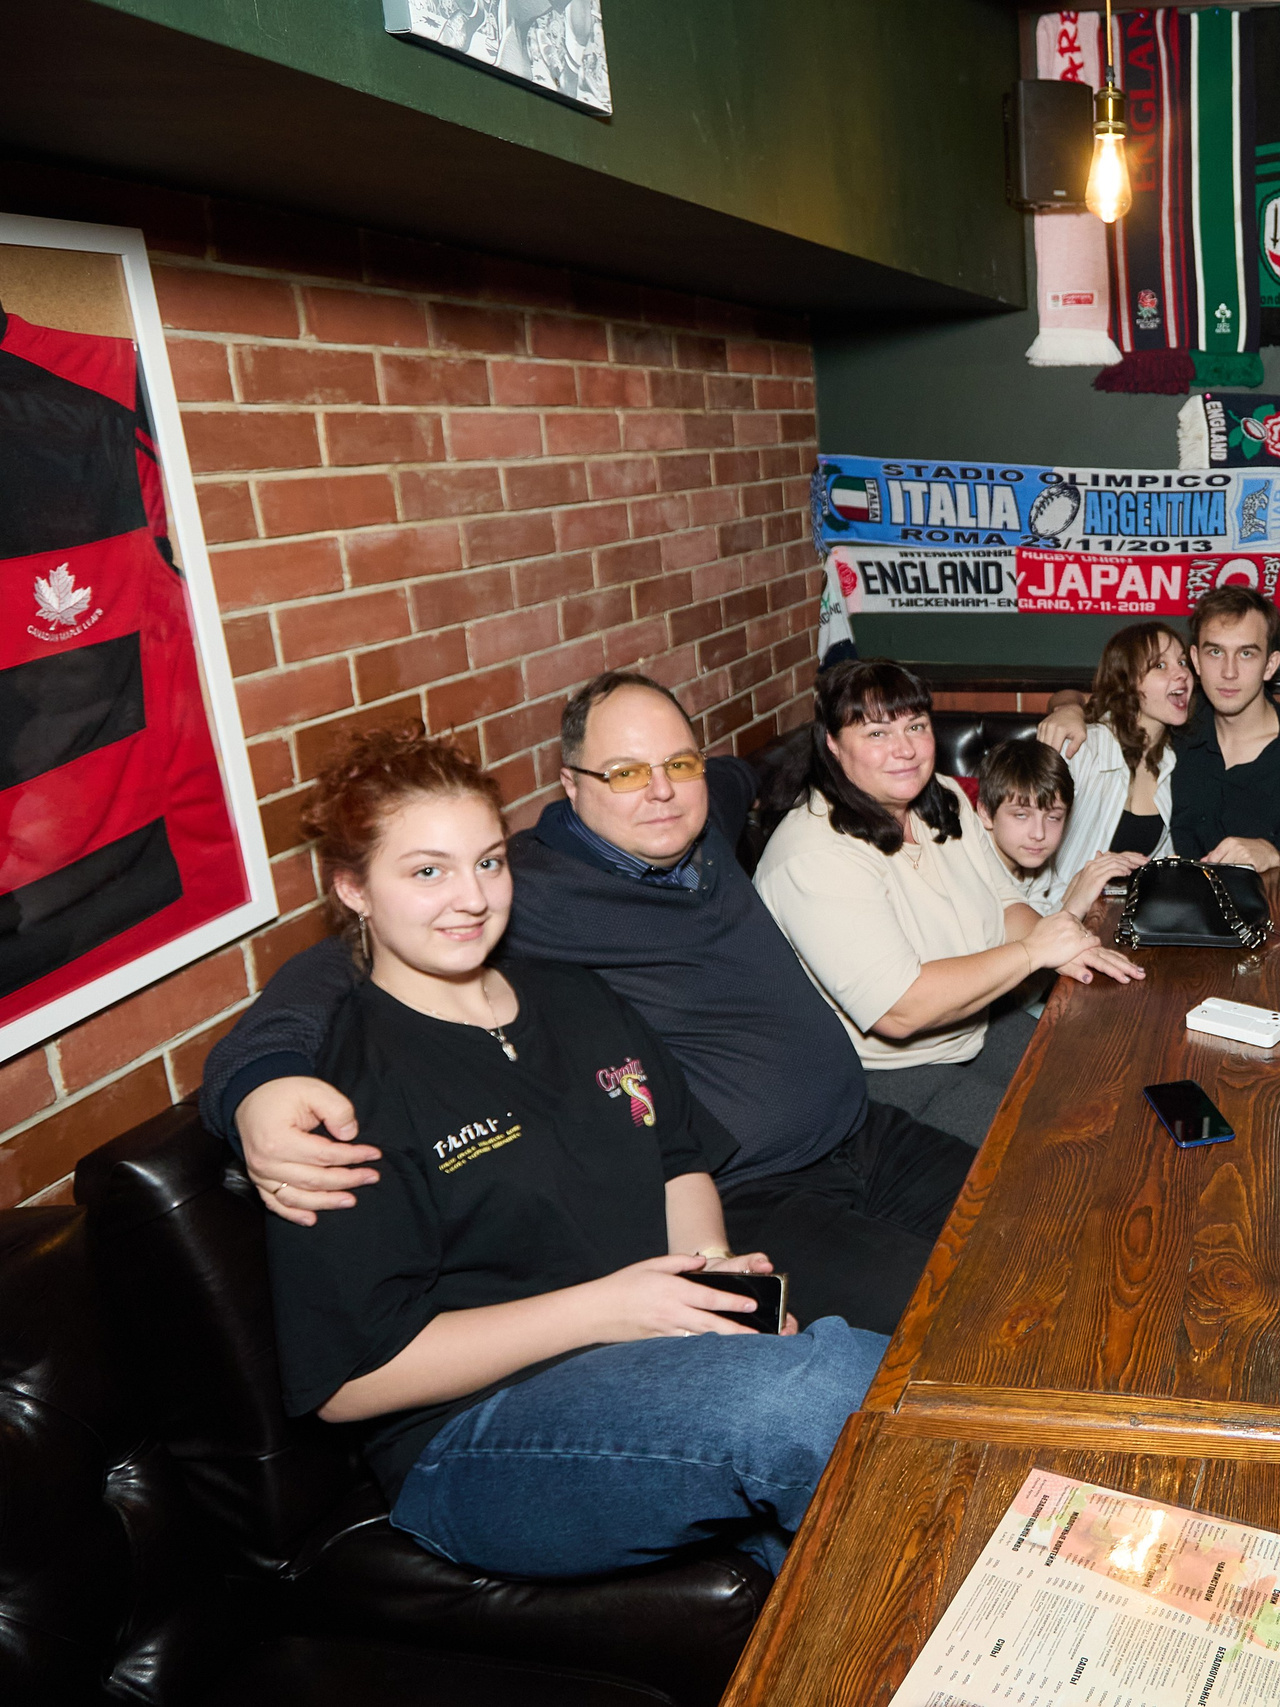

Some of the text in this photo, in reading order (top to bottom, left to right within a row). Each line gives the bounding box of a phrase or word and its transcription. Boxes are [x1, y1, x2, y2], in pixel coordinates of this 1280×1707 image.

[1204, 400, 1229, 463] ENGLAND
[881, 463, 1232, 488] STADIO OLIMPICO
[864, 479, 882, 522] ITALIA
[886, 479, 1022, 532] ITALIA
[1082, 489, 1228, 538] ARGENTINA
[900, 528, 1214, 552] ROMA 23/11/2013
[1021, 550, 1076, 563] RUGBY
[1081, 554, 1134, 565] UNION
[856, 560, 1004, 596] ENGLAND
[1027, 562, 1184, 601] JAPAN
[1077, 601, 1157, 613] 17-11-2018
[1204, 1572, 1221, 1602] ЛИСТОВОЙ
[990, 1638, 1005, 1658] СУПЫ
[1069, 1657, 1088, 1685] САЛАТЫ
[1198, 1646, 1226, 1707] БЕЗАЛКОГОЛЬНЫЕ
